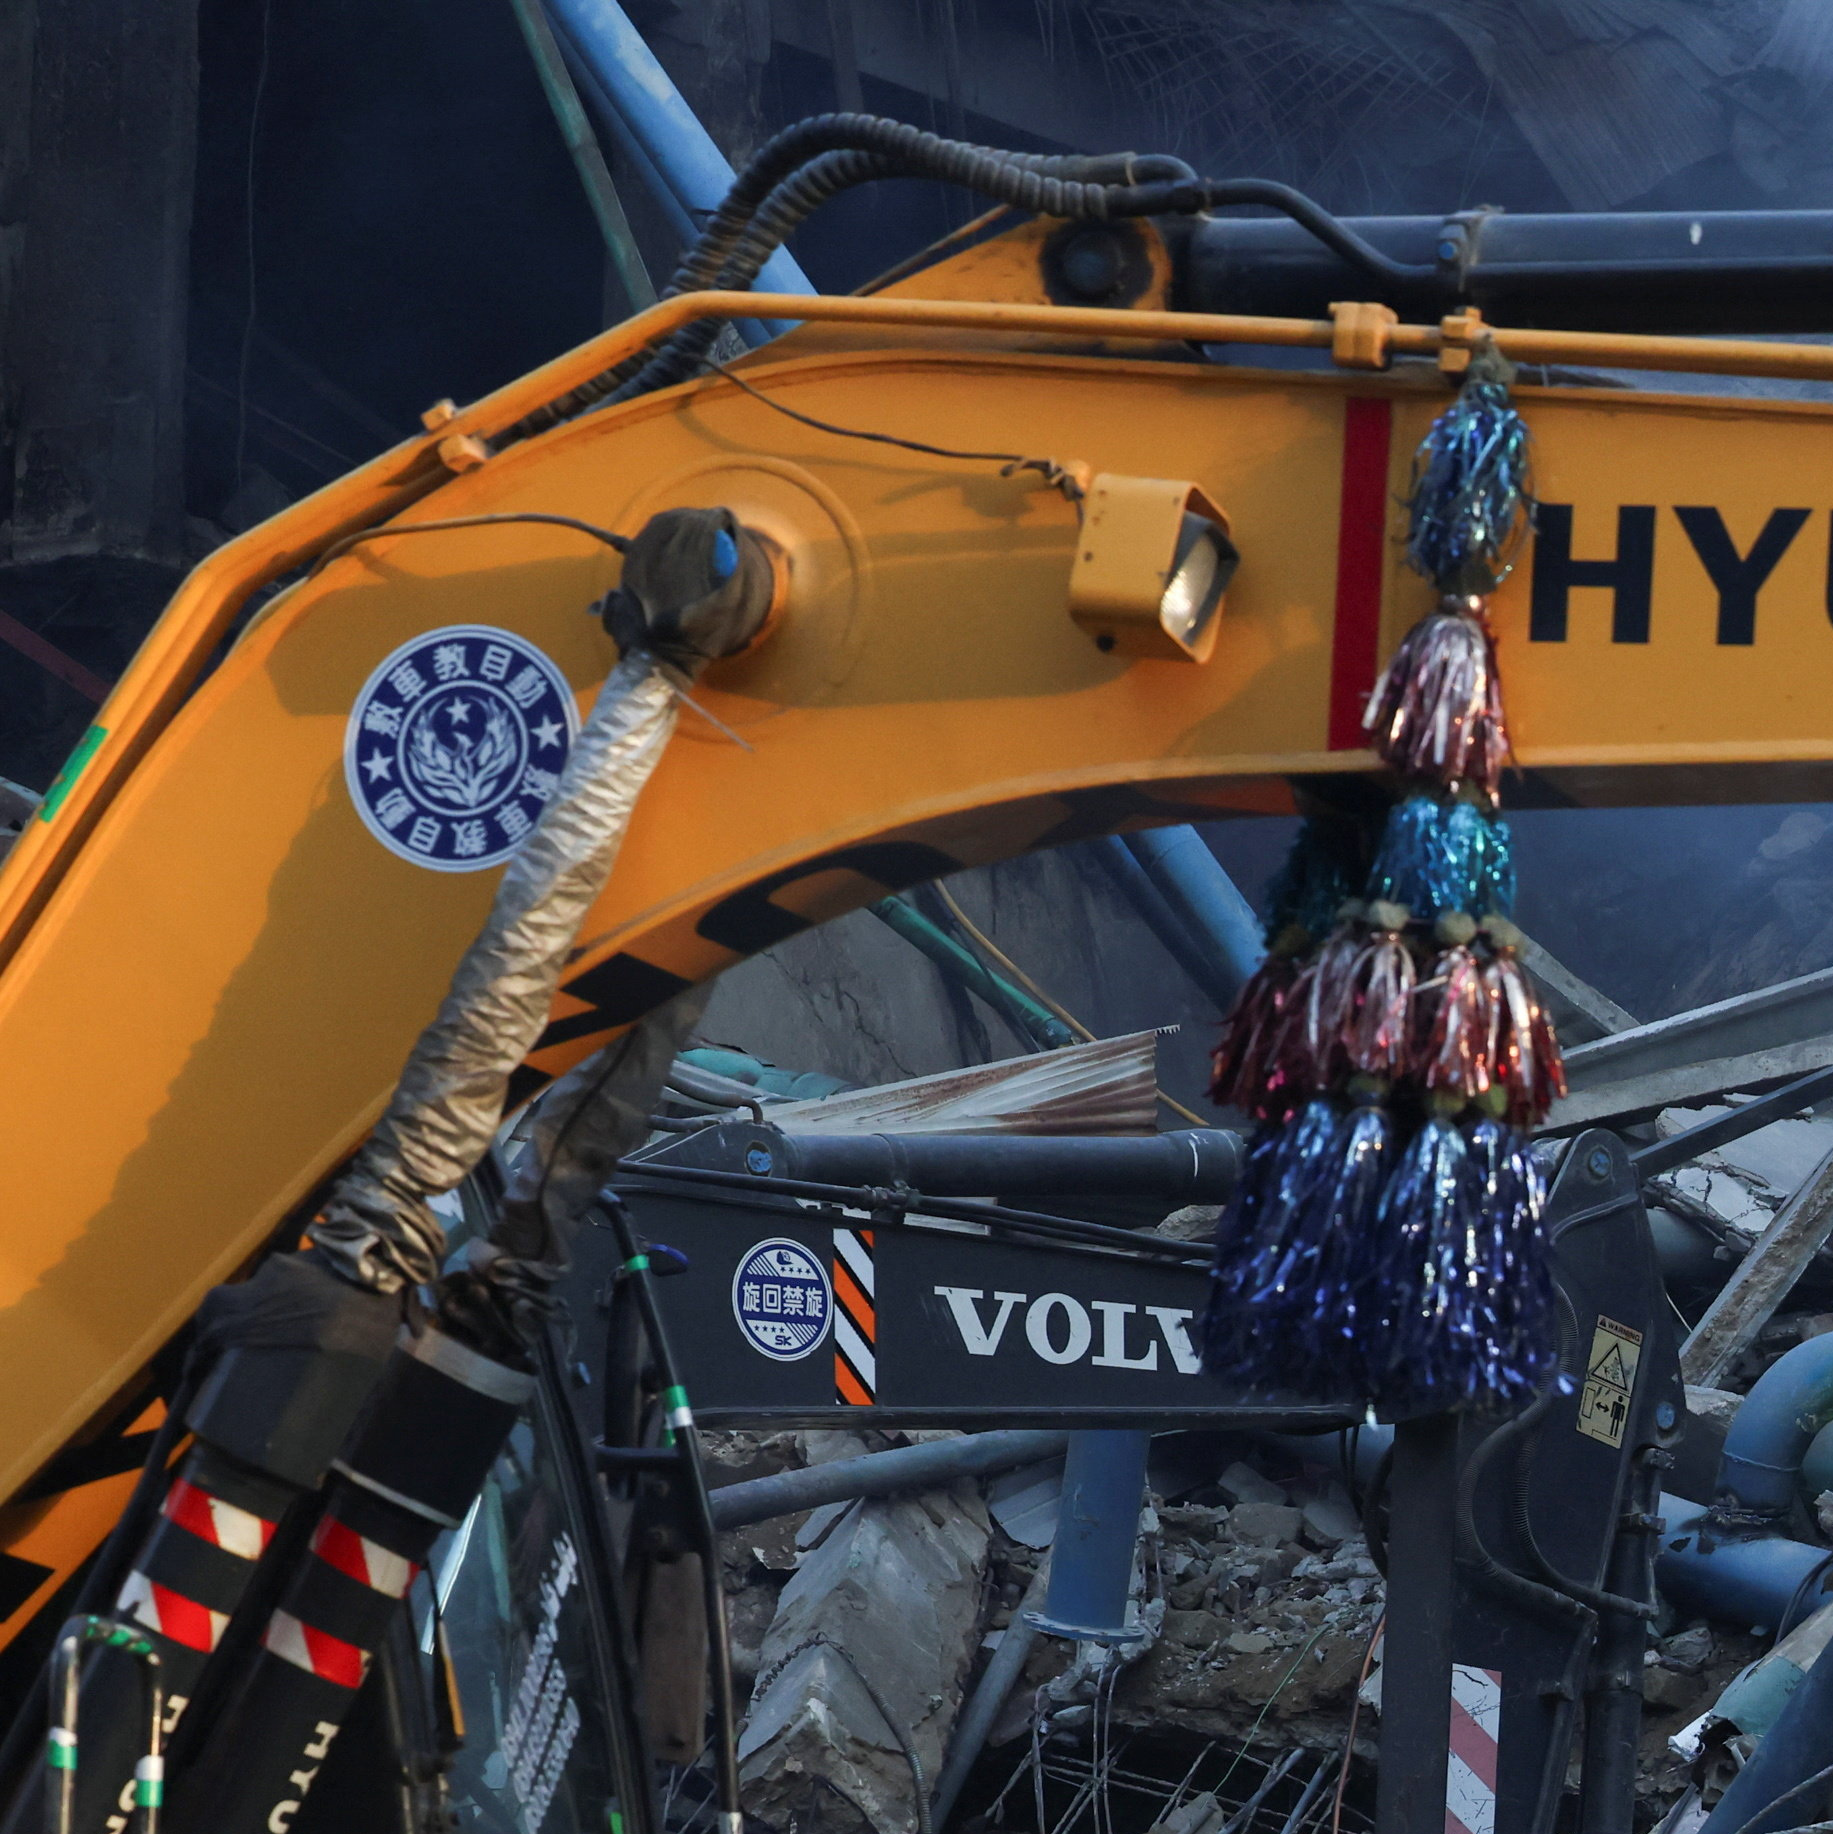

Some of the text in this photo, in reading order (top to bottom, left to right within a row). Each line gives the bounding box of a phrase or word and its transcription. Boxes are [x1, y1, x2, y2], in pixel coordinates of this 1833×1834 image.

[742, 1281, 824, 1318] 旋回禁旋
[774, 1335, 793, 1347] SK
[933, 1285, 1201, 1375] VOLV
[1607, 1320, 1641, 1343] WARNING
